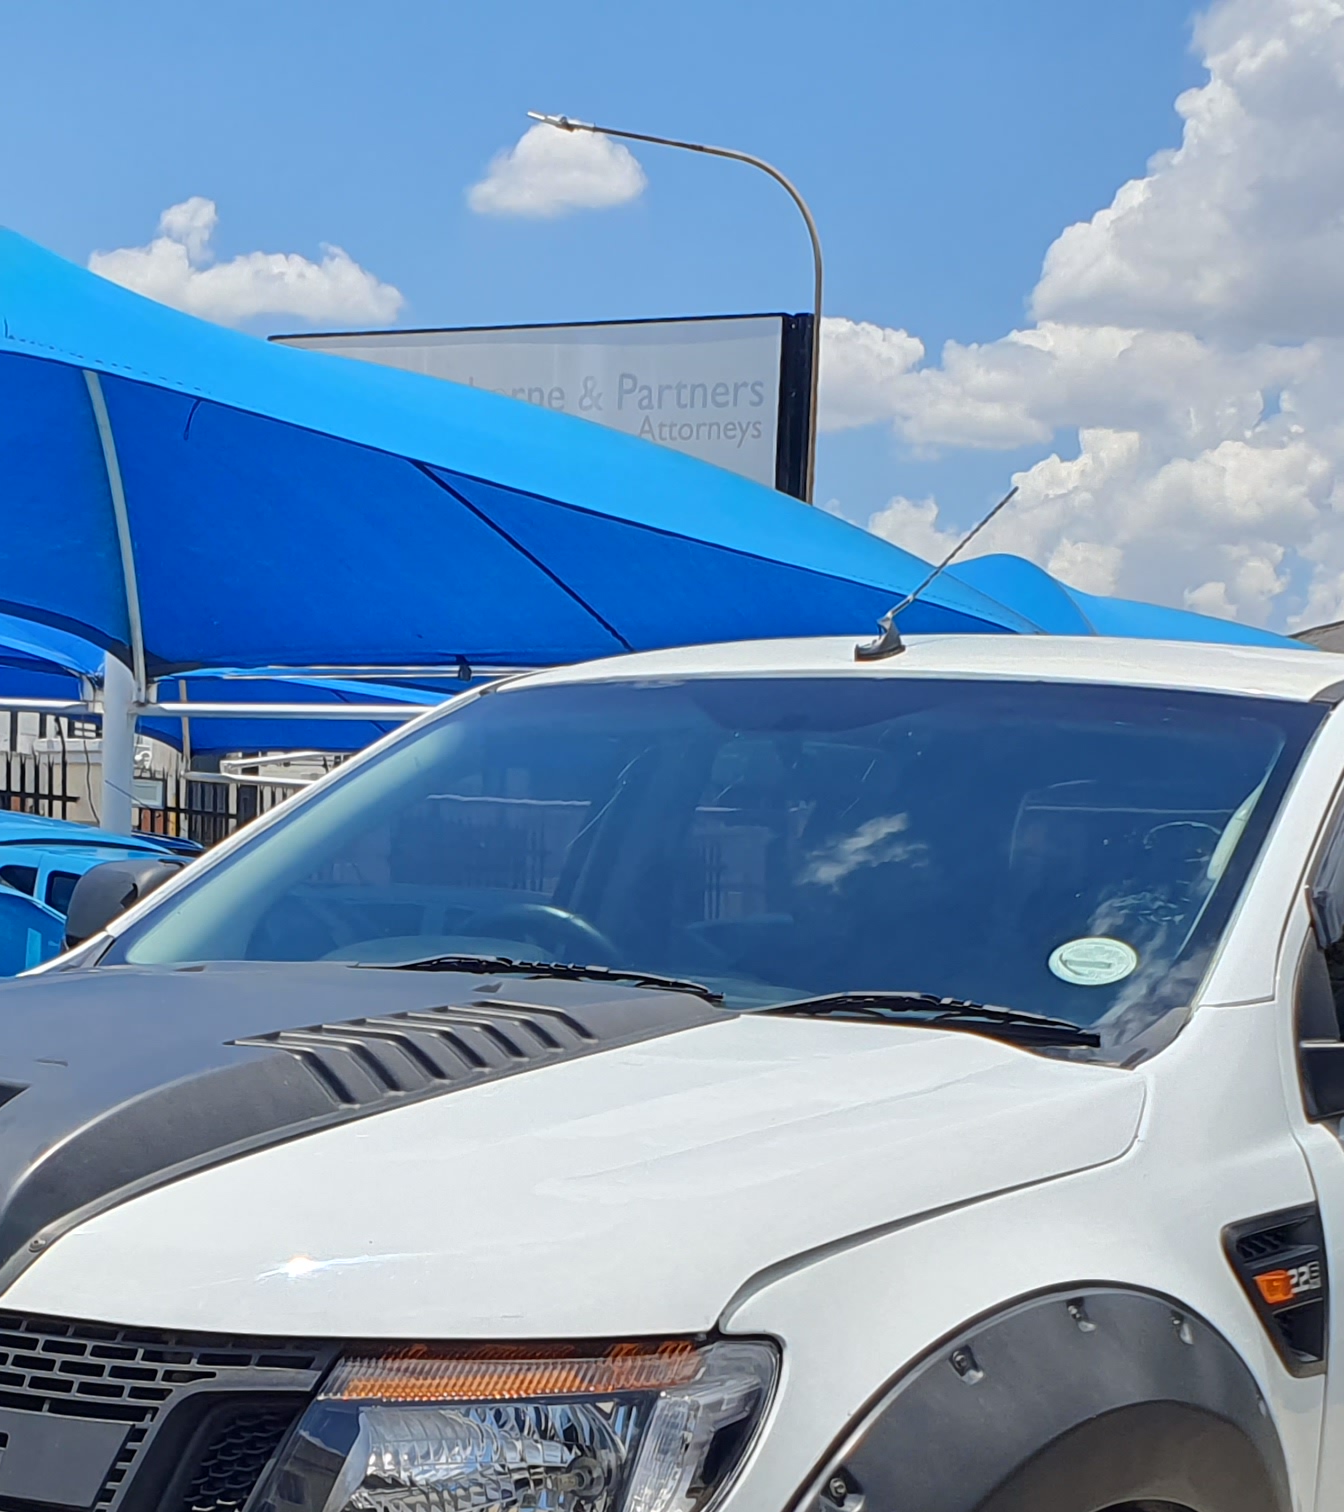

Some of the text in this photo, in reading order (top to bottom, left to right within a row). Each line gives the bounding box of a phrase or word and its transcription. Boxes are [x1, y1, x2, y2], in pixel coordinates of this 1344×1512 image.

[578, 375, 603, 411] &
[617, 372, 765, 410] Partners
[638, 415, 763, 448] Attorneys
